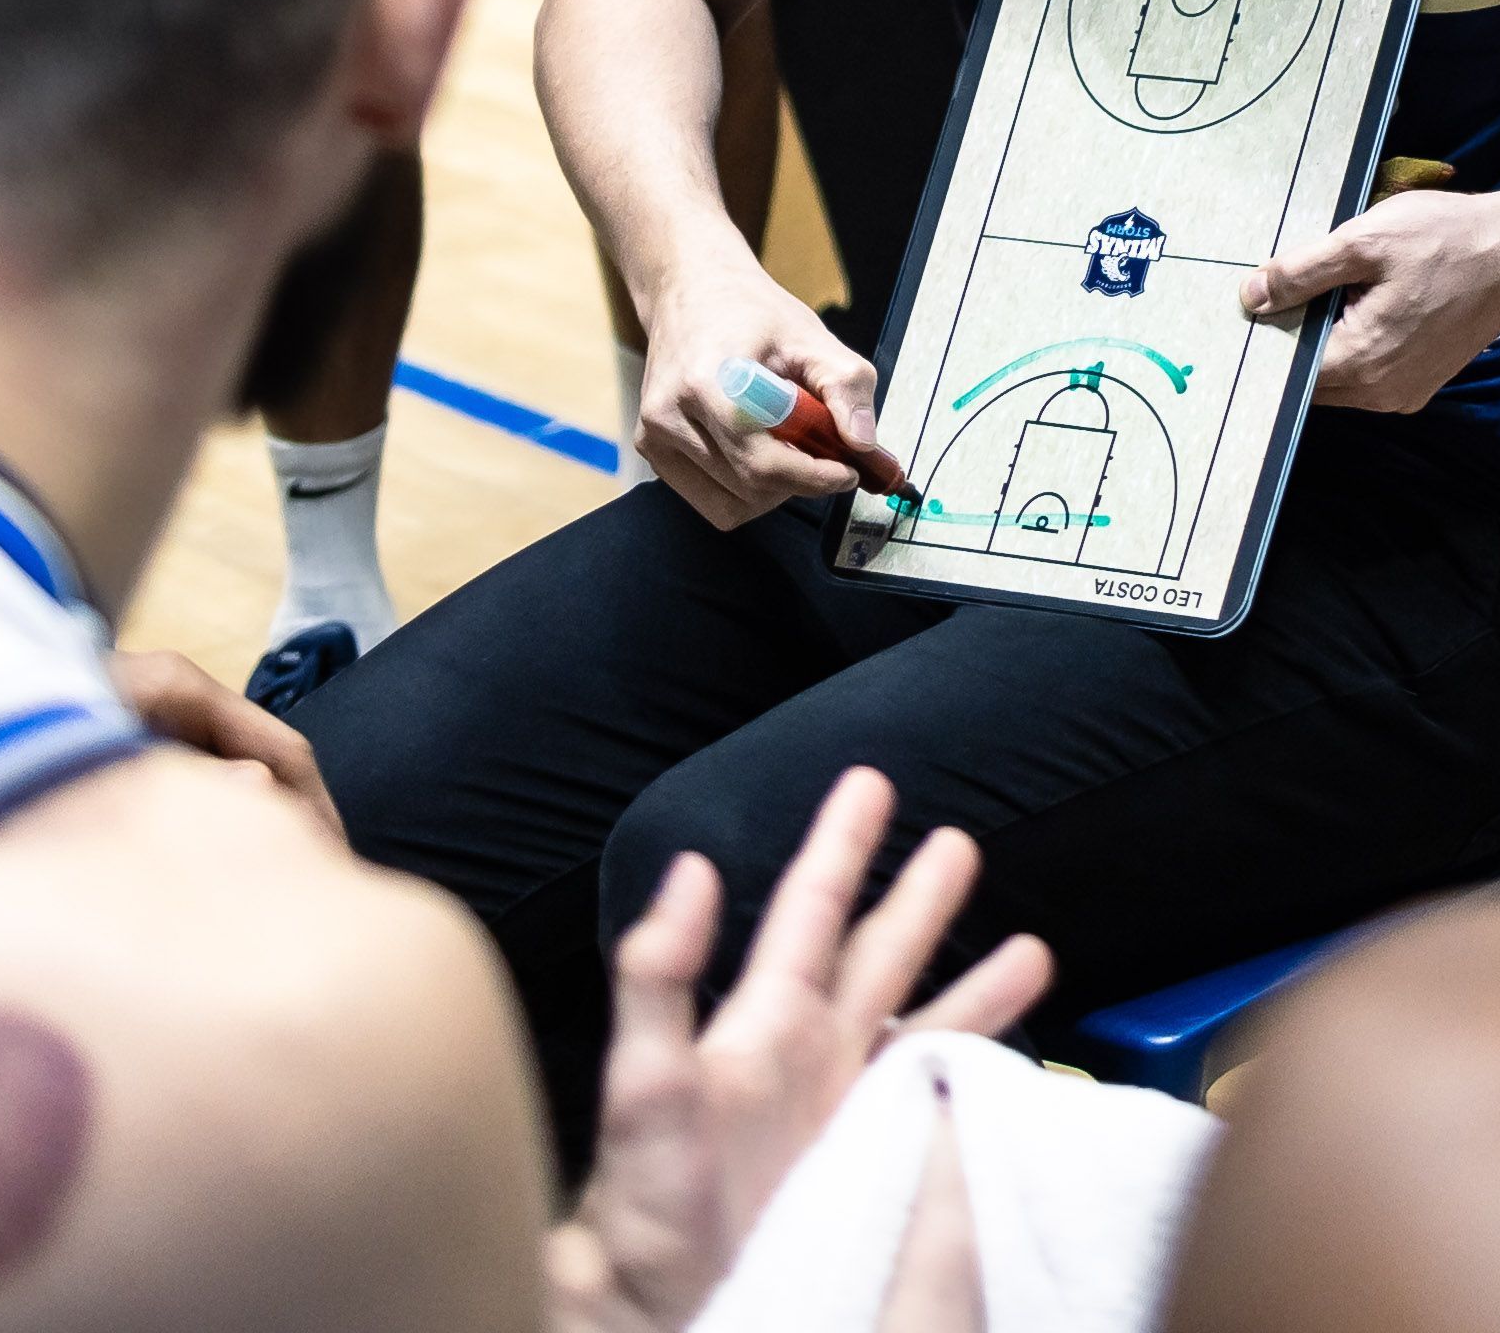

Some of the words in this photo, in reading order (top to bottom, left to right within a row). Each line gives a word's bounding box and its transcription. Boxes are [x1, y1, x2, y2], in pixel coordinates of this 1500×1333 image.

[1105, 224, 1151, 238] STORM
[1085, 229, 1166, 262] MINAS
[1095, 578, 1158, 602] COSTA
[1162, 588, 1203, 608] LEO
